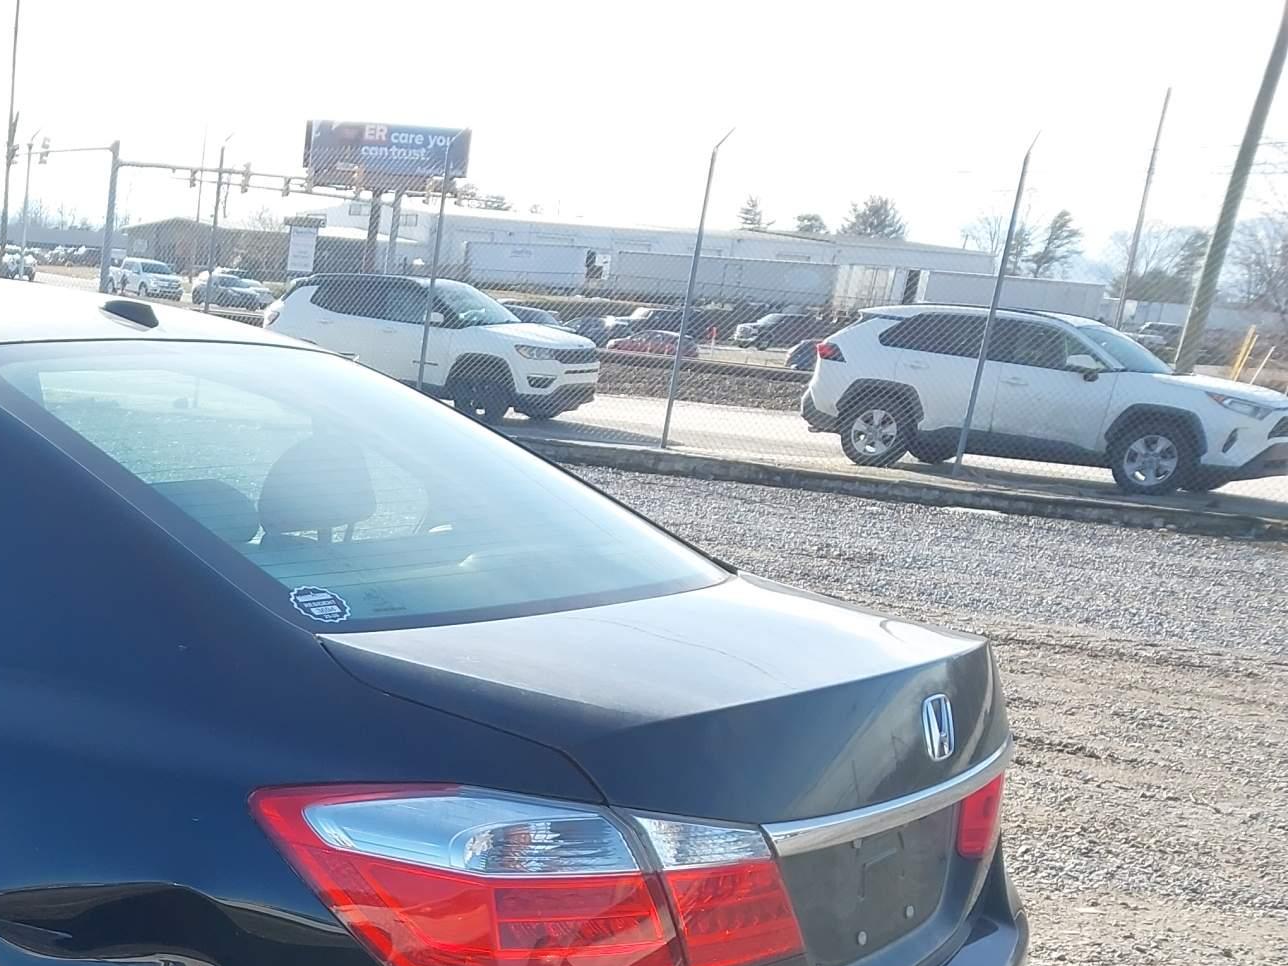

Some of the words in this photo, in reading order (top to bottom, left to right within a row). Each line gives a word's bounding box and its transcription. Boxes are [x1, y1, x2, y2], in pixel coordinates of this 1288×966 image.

[364, 124, 388, 141] ER
[391, 132, 425, 145] care
[361, 145, 389, 156] can
